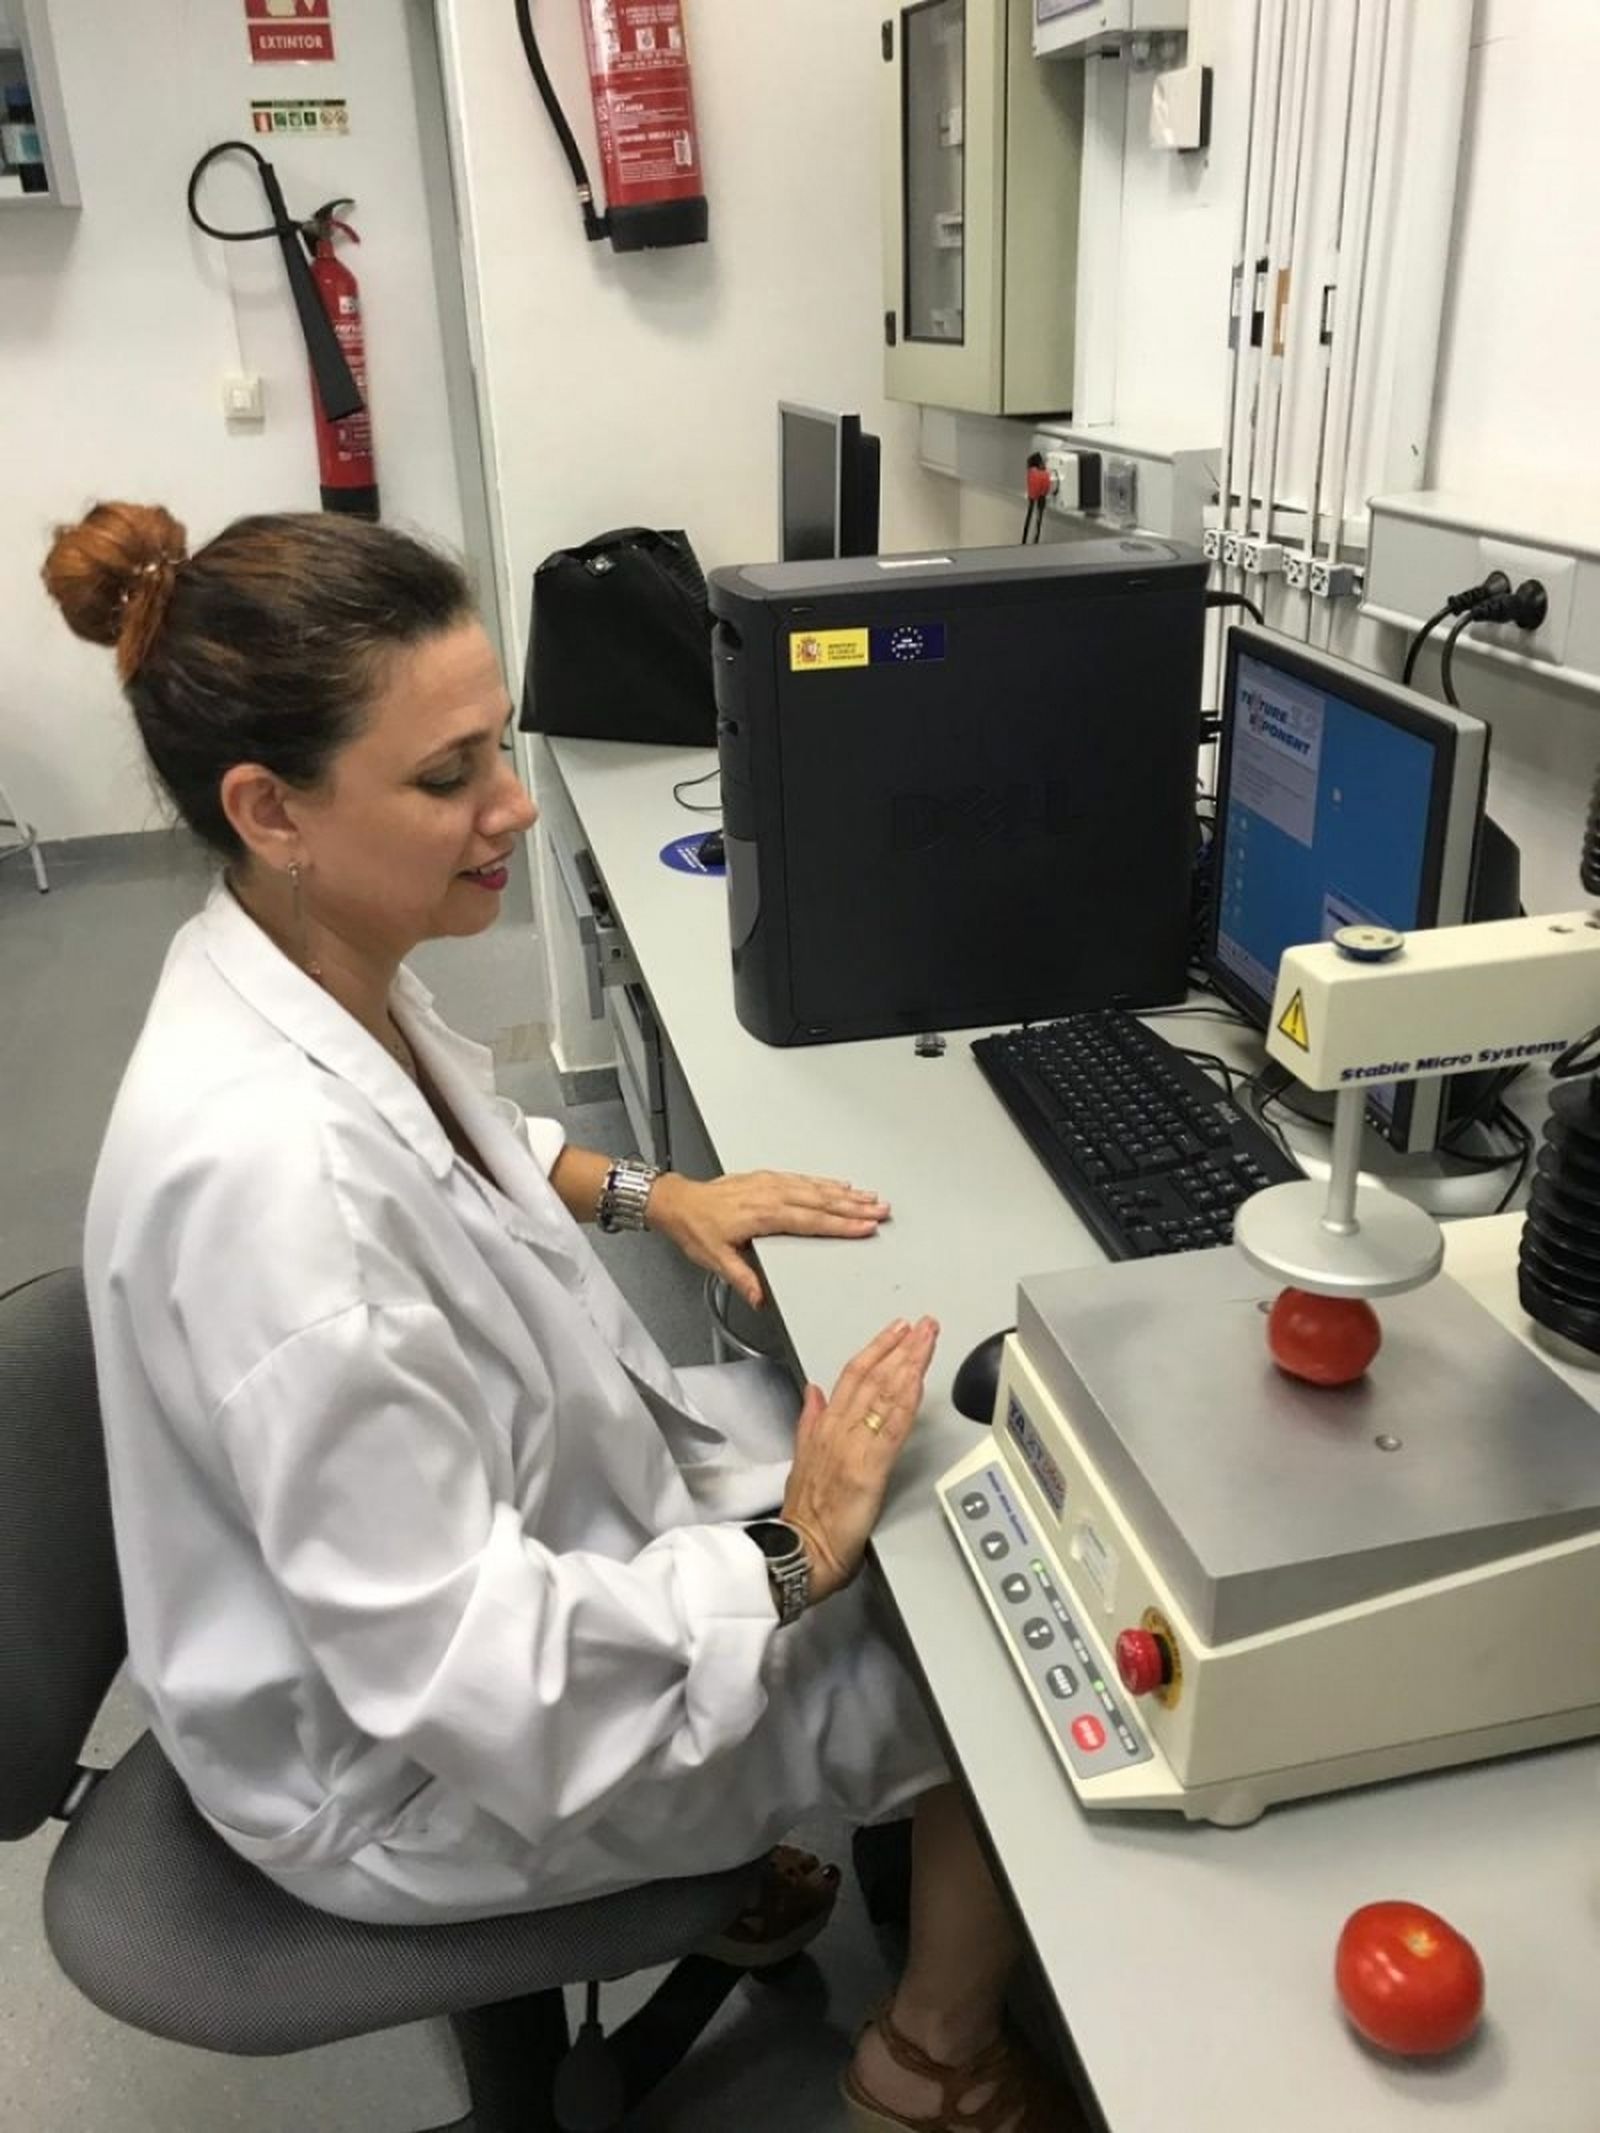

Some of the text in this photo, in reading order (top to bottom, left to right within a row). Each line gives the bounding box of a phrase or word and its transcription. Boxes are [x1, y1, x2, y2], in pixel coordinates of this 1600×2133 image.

[259, 34, 324, 49] EXTINTOR
[1340, 1040, 1568, 1081] Stable Micro Systems
